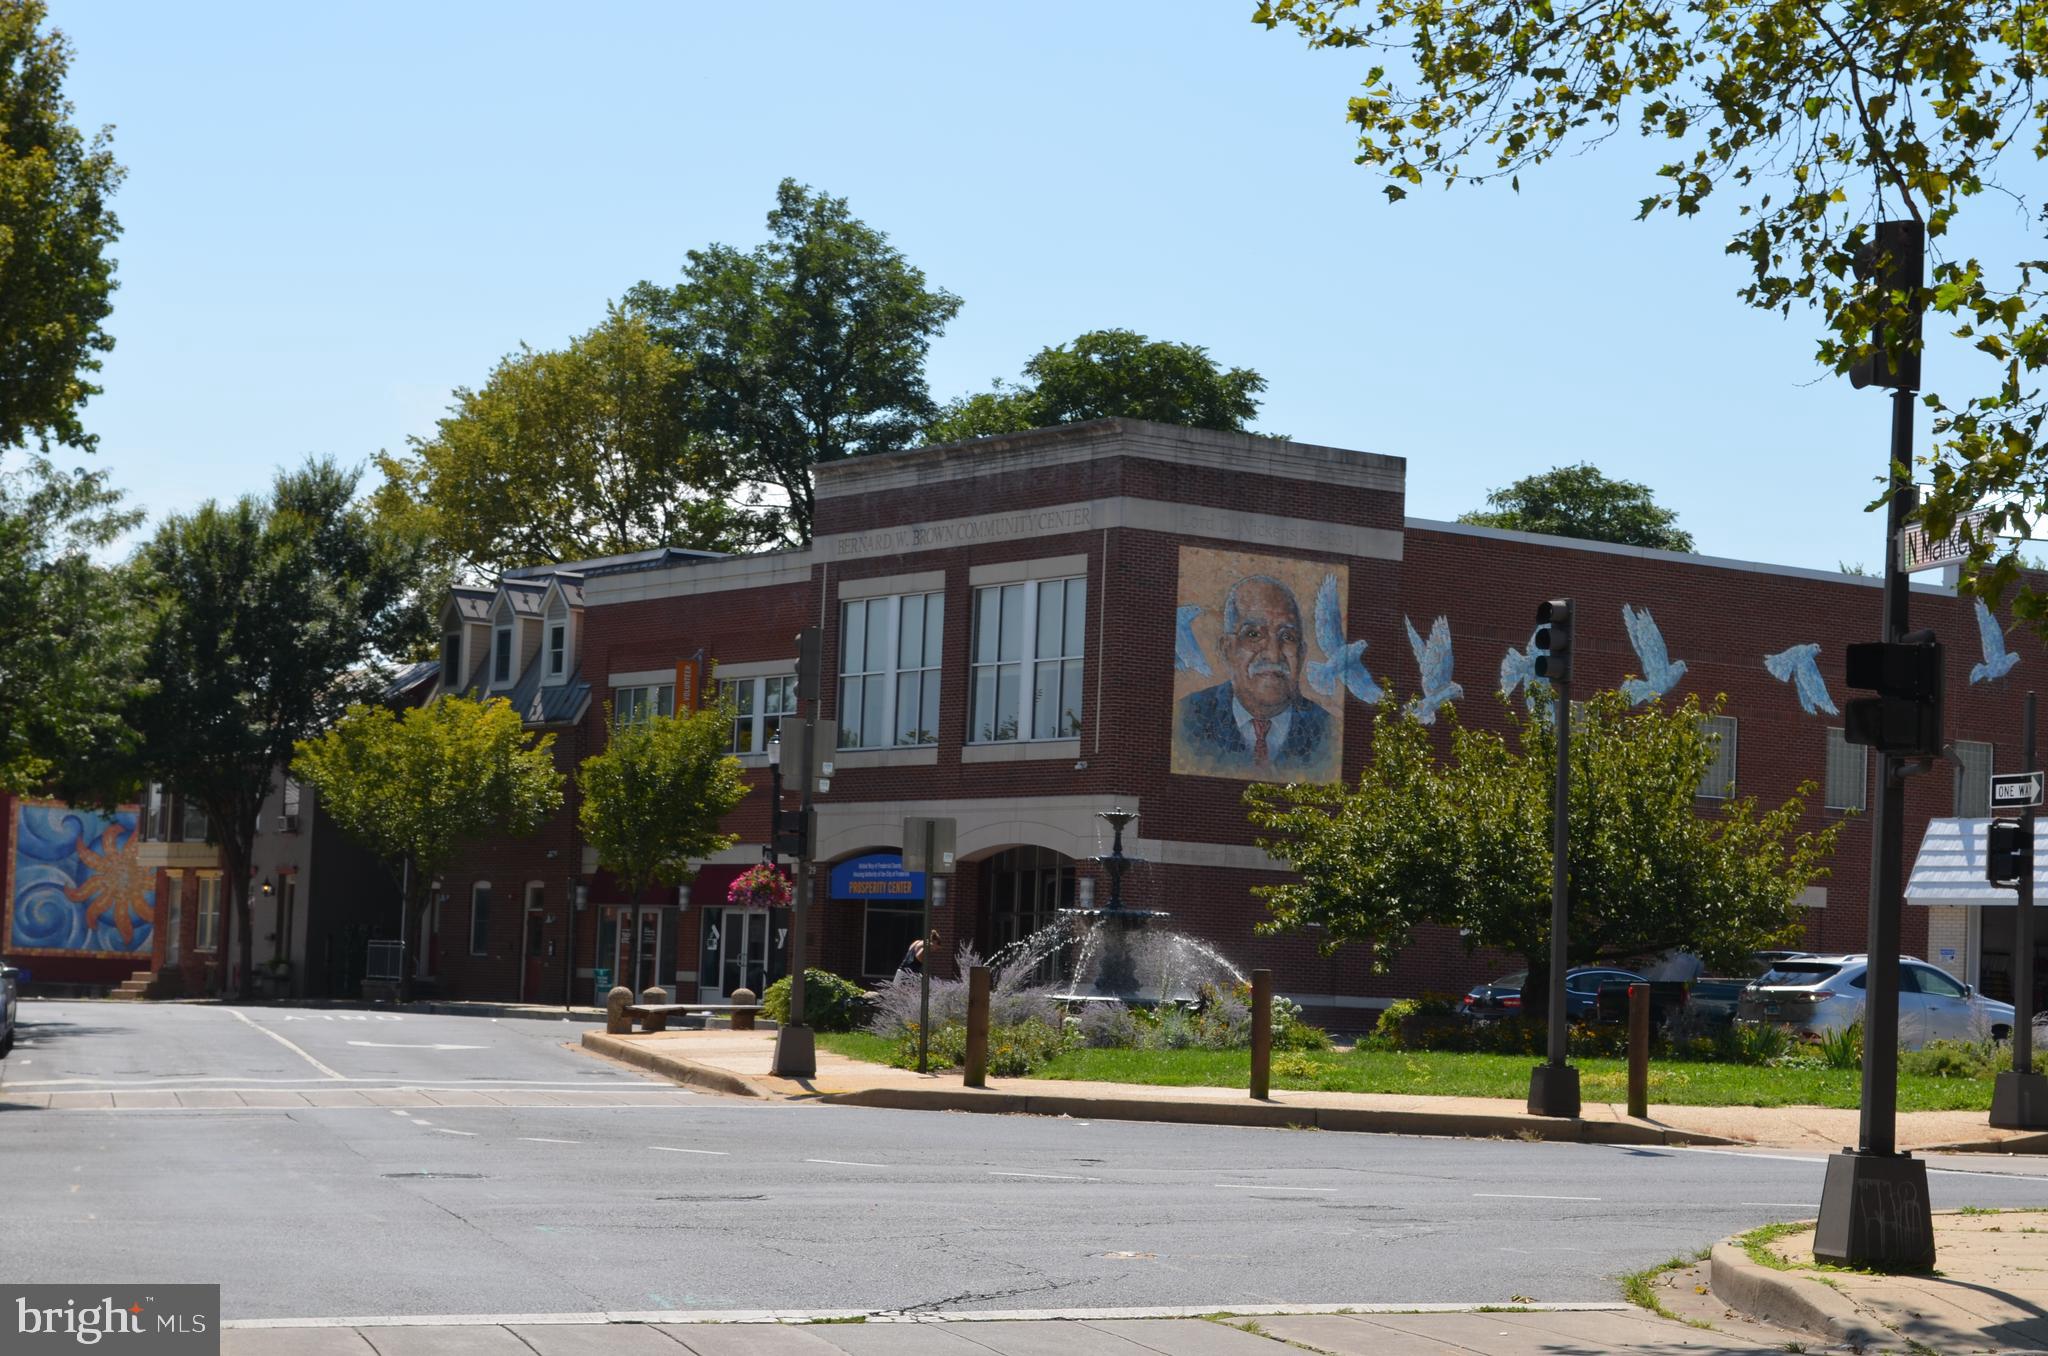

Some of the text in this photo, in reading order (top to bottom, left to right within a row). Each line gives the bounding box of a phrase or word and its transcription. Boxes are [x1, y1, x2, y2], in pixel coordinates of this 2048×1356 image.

[837, 507, 1091, 556] BERNARD W. BROWN COMMUNITY CENTER
[1239, 519, 1297, 541] Nickens
[1922, 529, 1975, 563] Marke
[1999, 784, 2032, 798] ONE WAY
[848, 881, 913, 895] PROSPERITY CENTER
